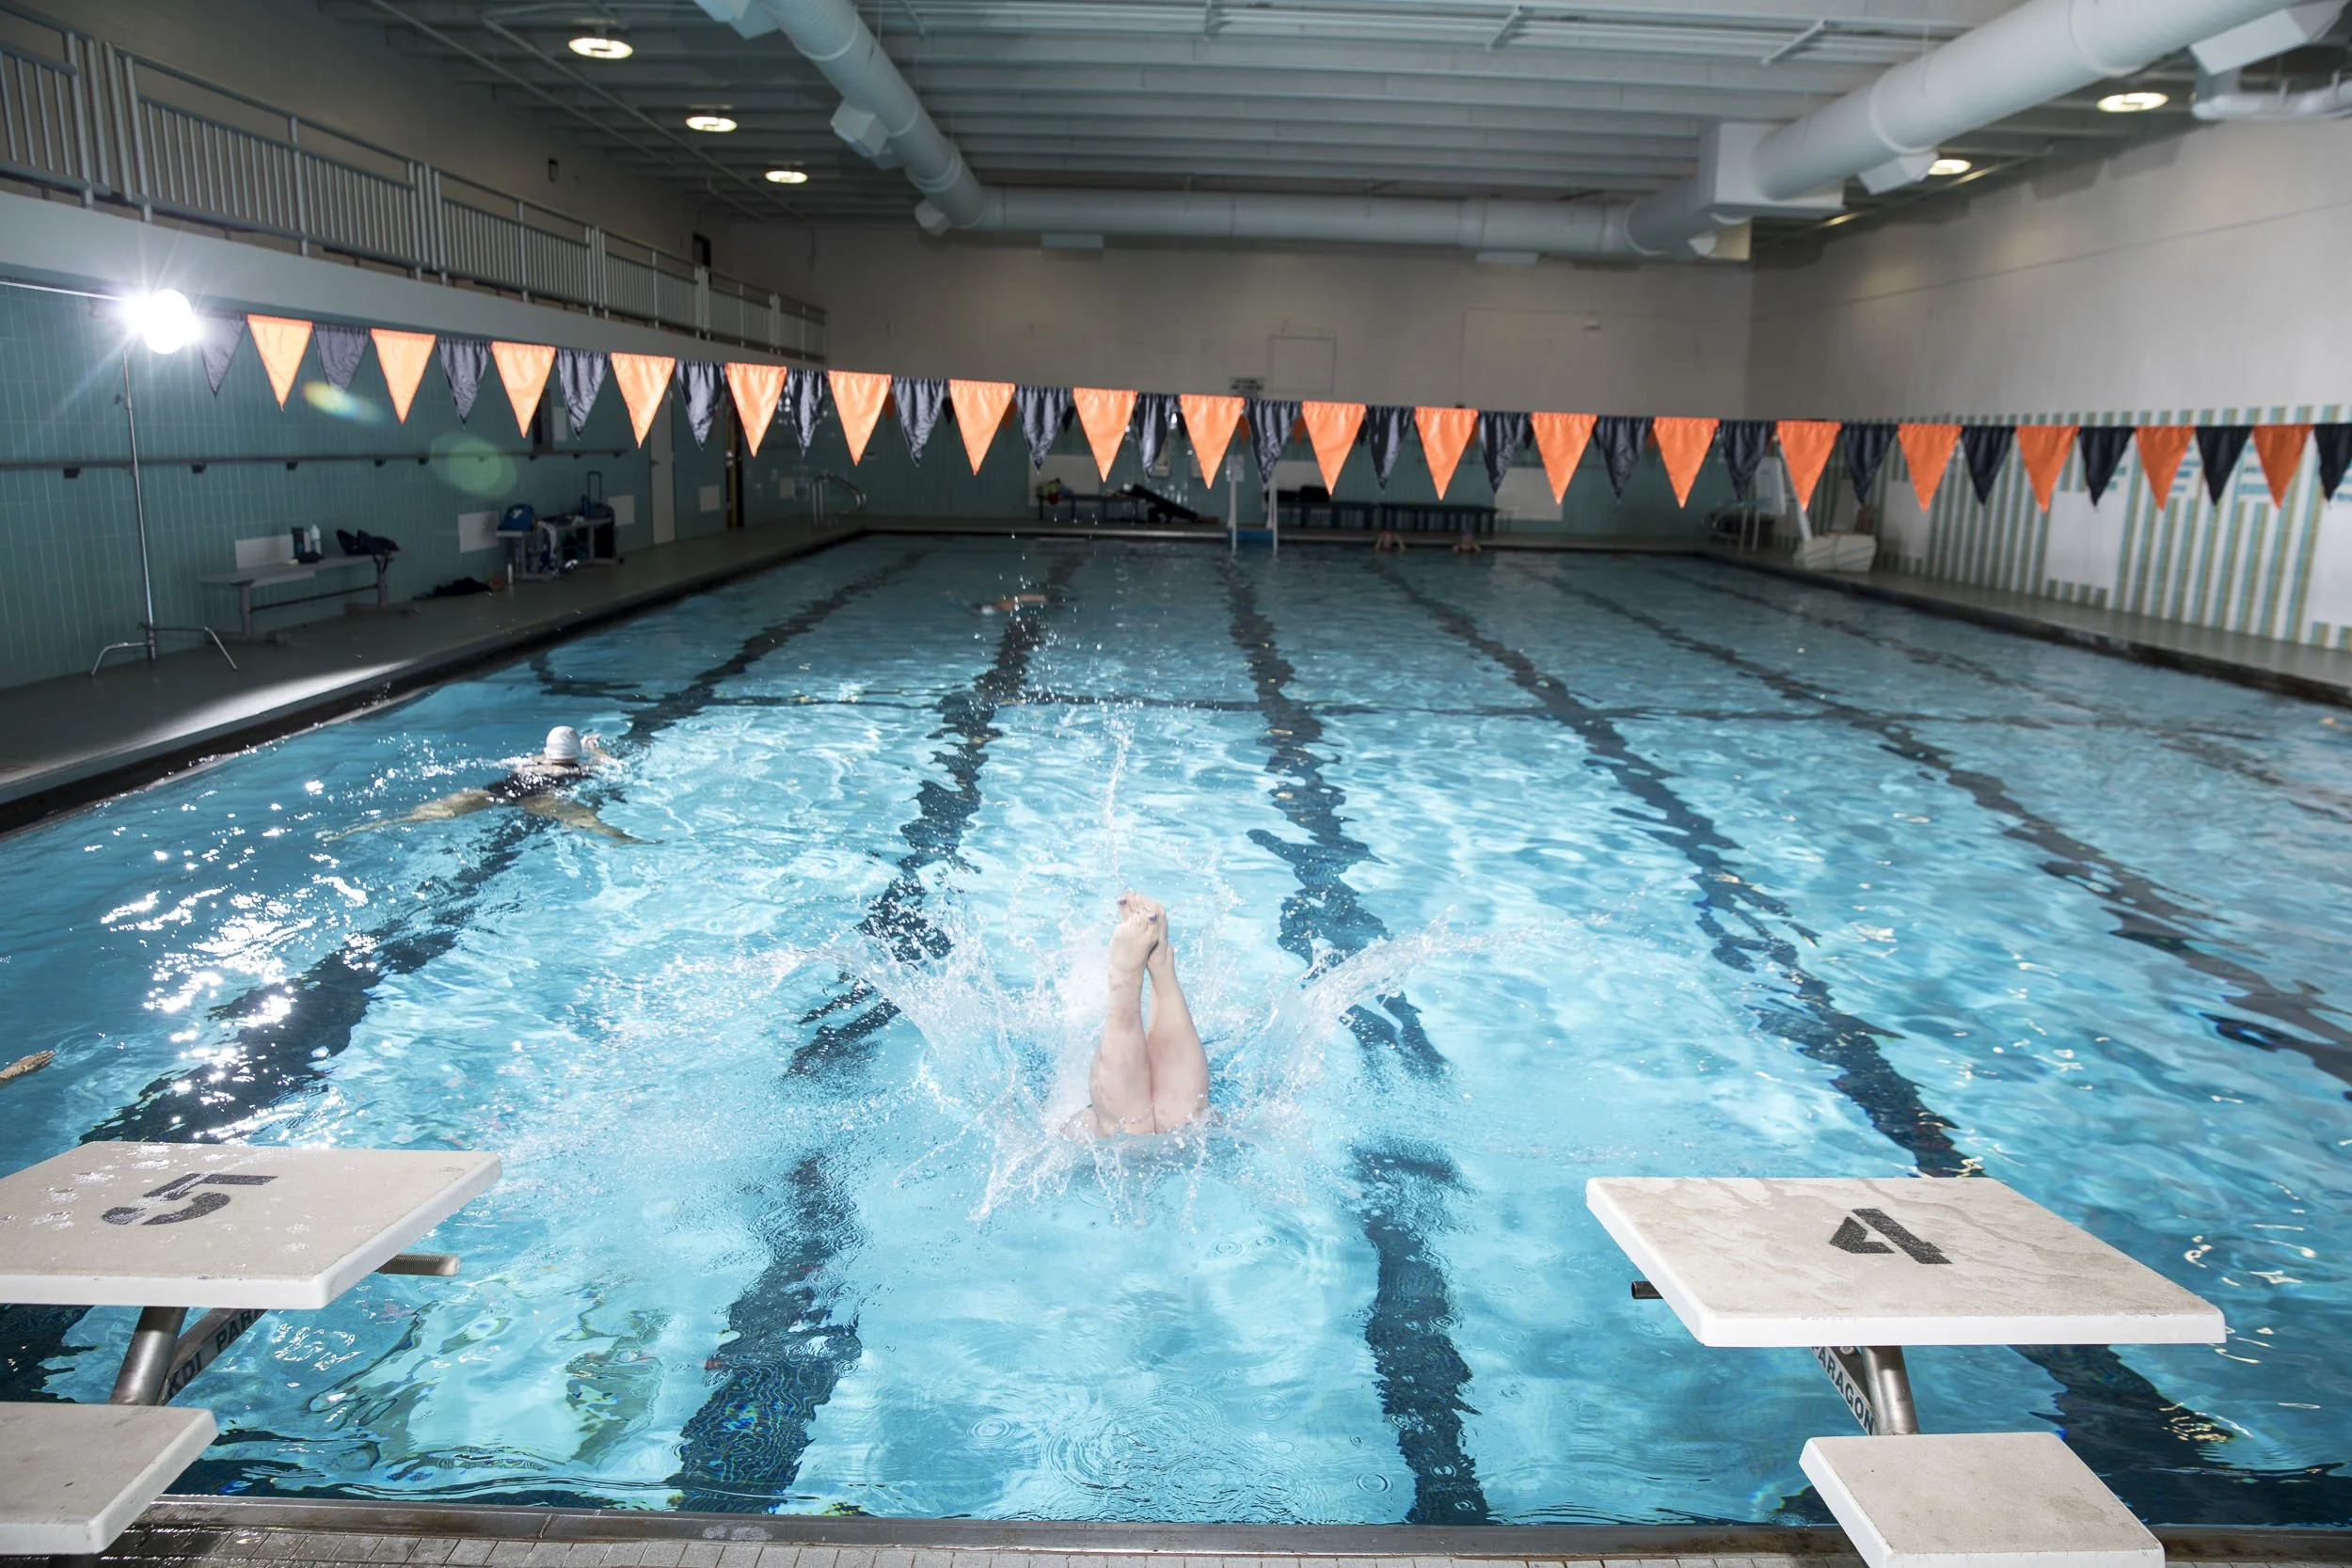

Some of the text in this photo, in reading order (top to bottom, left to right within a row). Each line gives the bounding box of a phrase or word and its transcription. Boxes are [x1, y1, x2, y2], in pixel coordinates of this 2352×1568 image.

[102, 1173, 278, 1225] 5
[1829, 1208, 1953, 1264] 4
[1811, 1346, 1874, 1435] ARAGON
